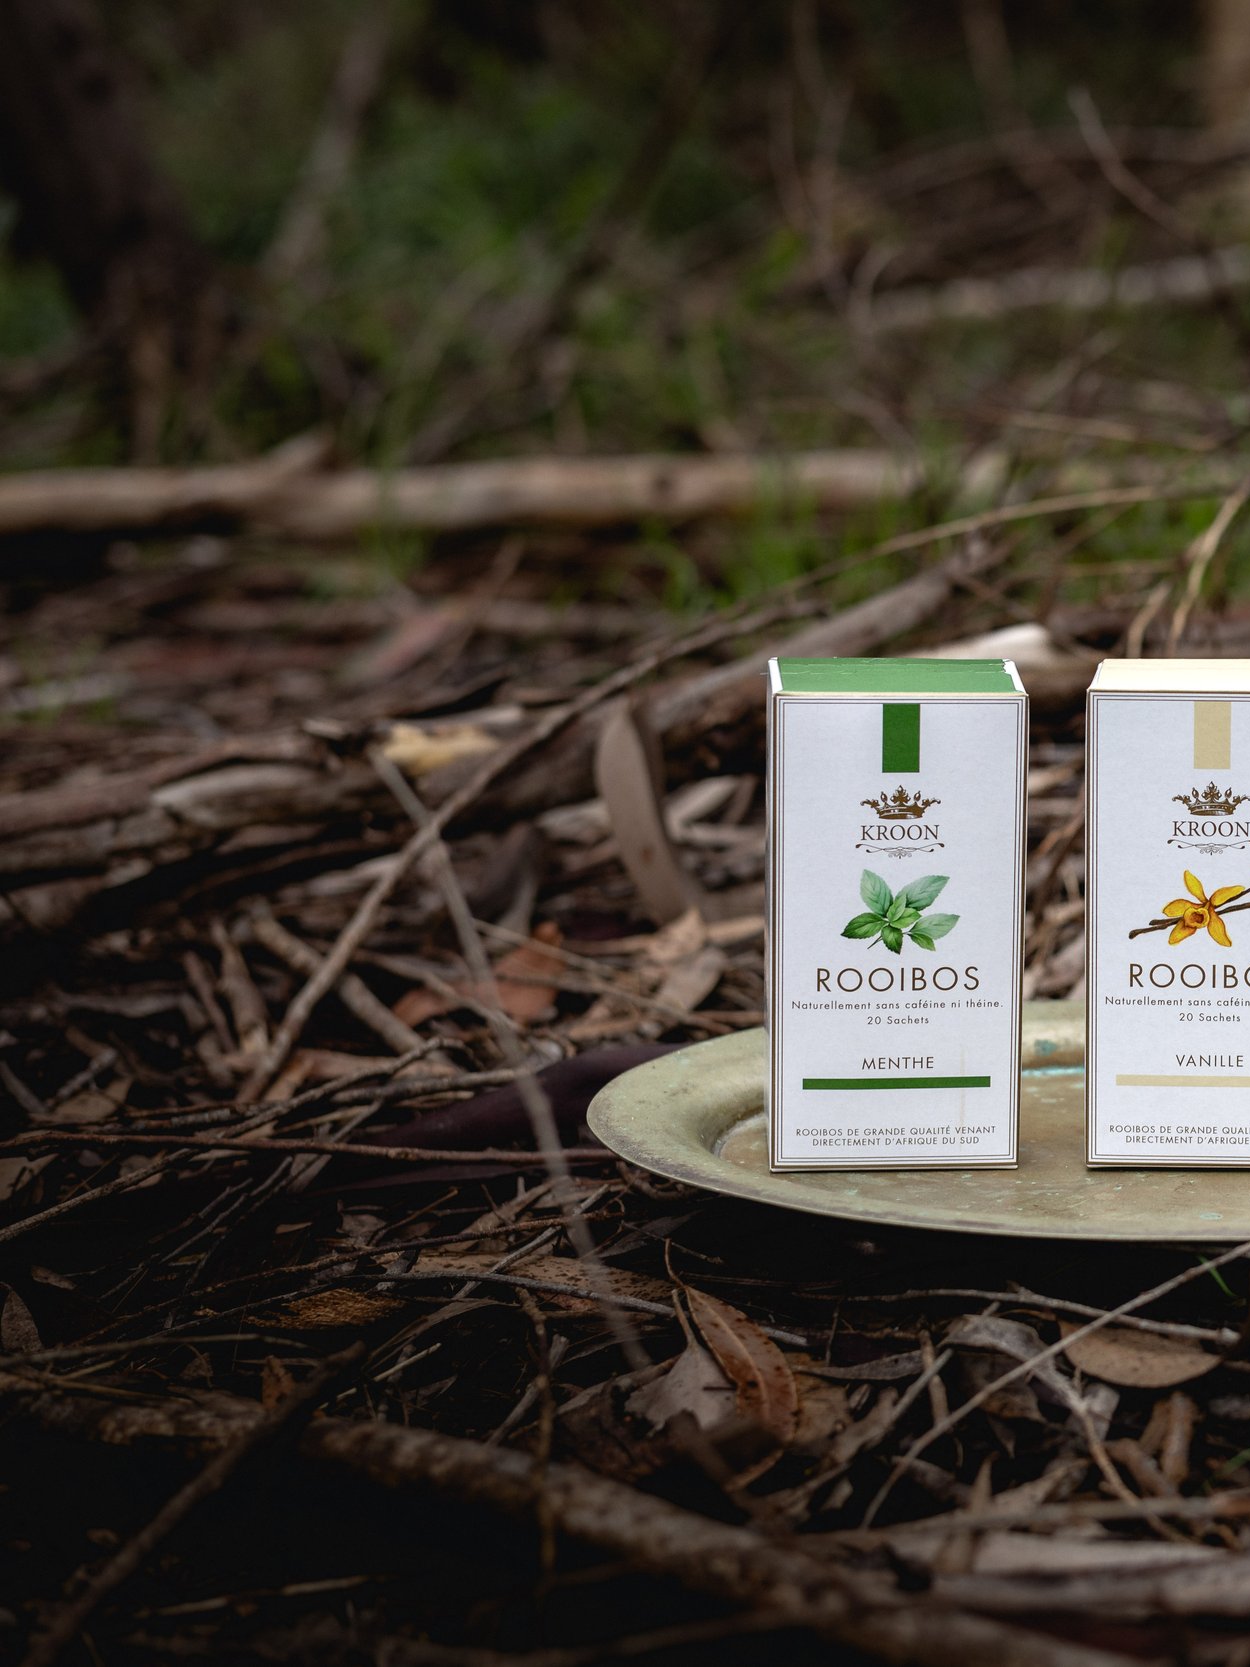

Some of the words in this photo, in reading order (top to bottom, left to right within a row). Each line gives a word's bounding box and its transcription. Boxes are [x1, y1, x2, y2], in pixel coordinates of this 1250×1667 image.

[861, 825, 940, 841] KROON
[1172, 821, 1250, 837] KROON
[816, 966, 980, 992] ROOIBOS
[792, 1000, 871, 1010] Naturellement
[876, 1002, 900, 1010] sans
[905, 999, 945, 1009] caféine
[951, 1000, 960, 1009] ni
[966, 999, 1003, 1008] théine.
[1105, 996, 1183, 1007] Naturellement
[1188, 999, 1212, 1007] sans
[867, 1016, 881, 1025] 20
[887, 1015, 929, 1025] Sachets
[1179, 1013, 1193, 1022] 20
[1199, 1013, 1241, 1022] Sachets
[862, 1057, 934, 1070] MENTHE
[1176, 1055, 1244, 1068] VANILLE
[796, 1128, 843, 1136] ROOIBOS
[847, 1128, 859, 1136] DE
[864, 1127, 905, 1136] GRANDE
[910, 1125, 951, 1136] QUALITÉ
[955, 1126, 996, 1135] VENANT
[1109, 1125, 1155, 1134] ROOIBOS
[1160, 1126, 1171, 1134] DE
[1176, 1126, 1217, 1135] GRANDE
[812, 1138, 881, 1146] DIRECTEMENT
[885, 1137, 938, 1146] D'AFRIQUE
[942, 1137, 956, 1145] DU
[960, 1136, 979, 1144] SUD
[1125, 1136, 1192, 1144] DIRECTEMENT
[1198, 1136, 1250, 1145] D'AFRIQUE
